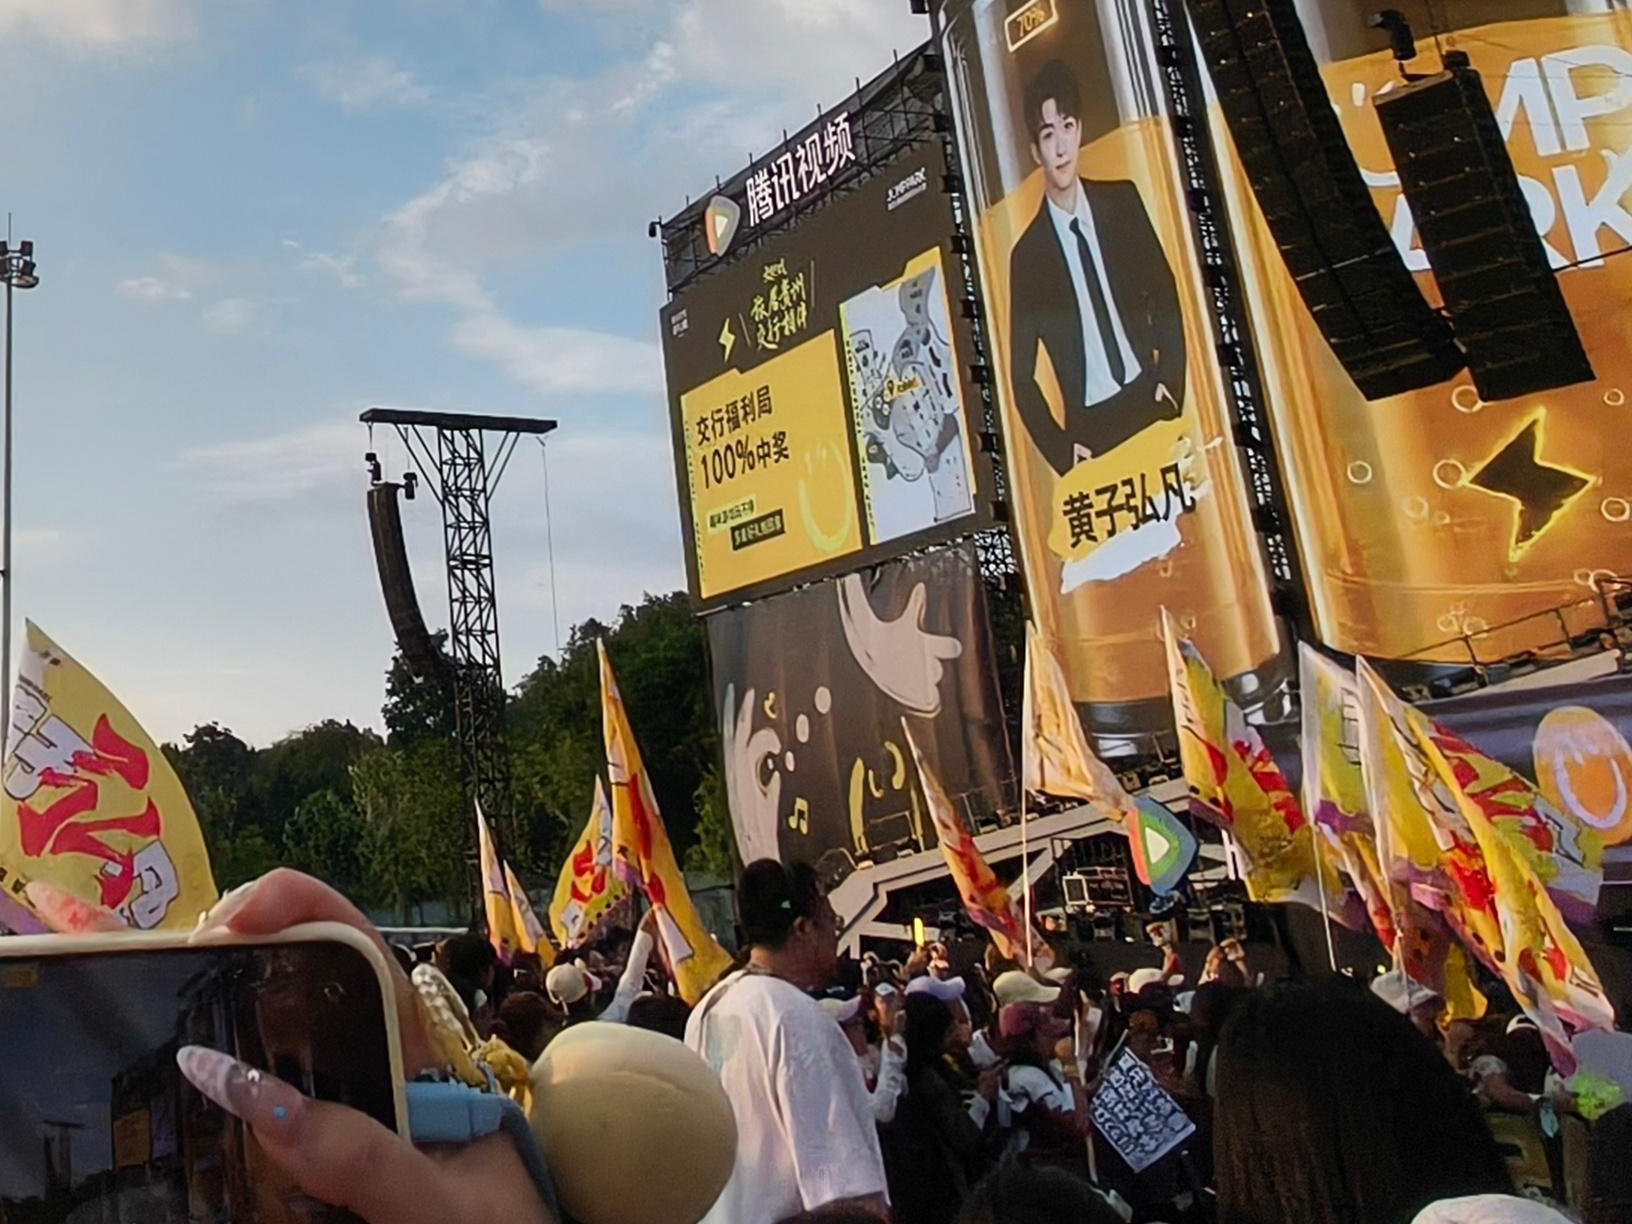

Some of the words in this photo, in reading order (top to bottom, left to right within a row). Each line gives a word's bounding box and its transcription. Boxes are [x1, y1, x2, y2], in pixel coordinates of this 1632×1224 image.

[746, 111, 856, 227] 腾讯视频
[696, 384, 773, 447] 交行福利局
[701, 431, 789, 489] 100%中奖
[1062, 462, 1197, 549] 黄子弘凡
